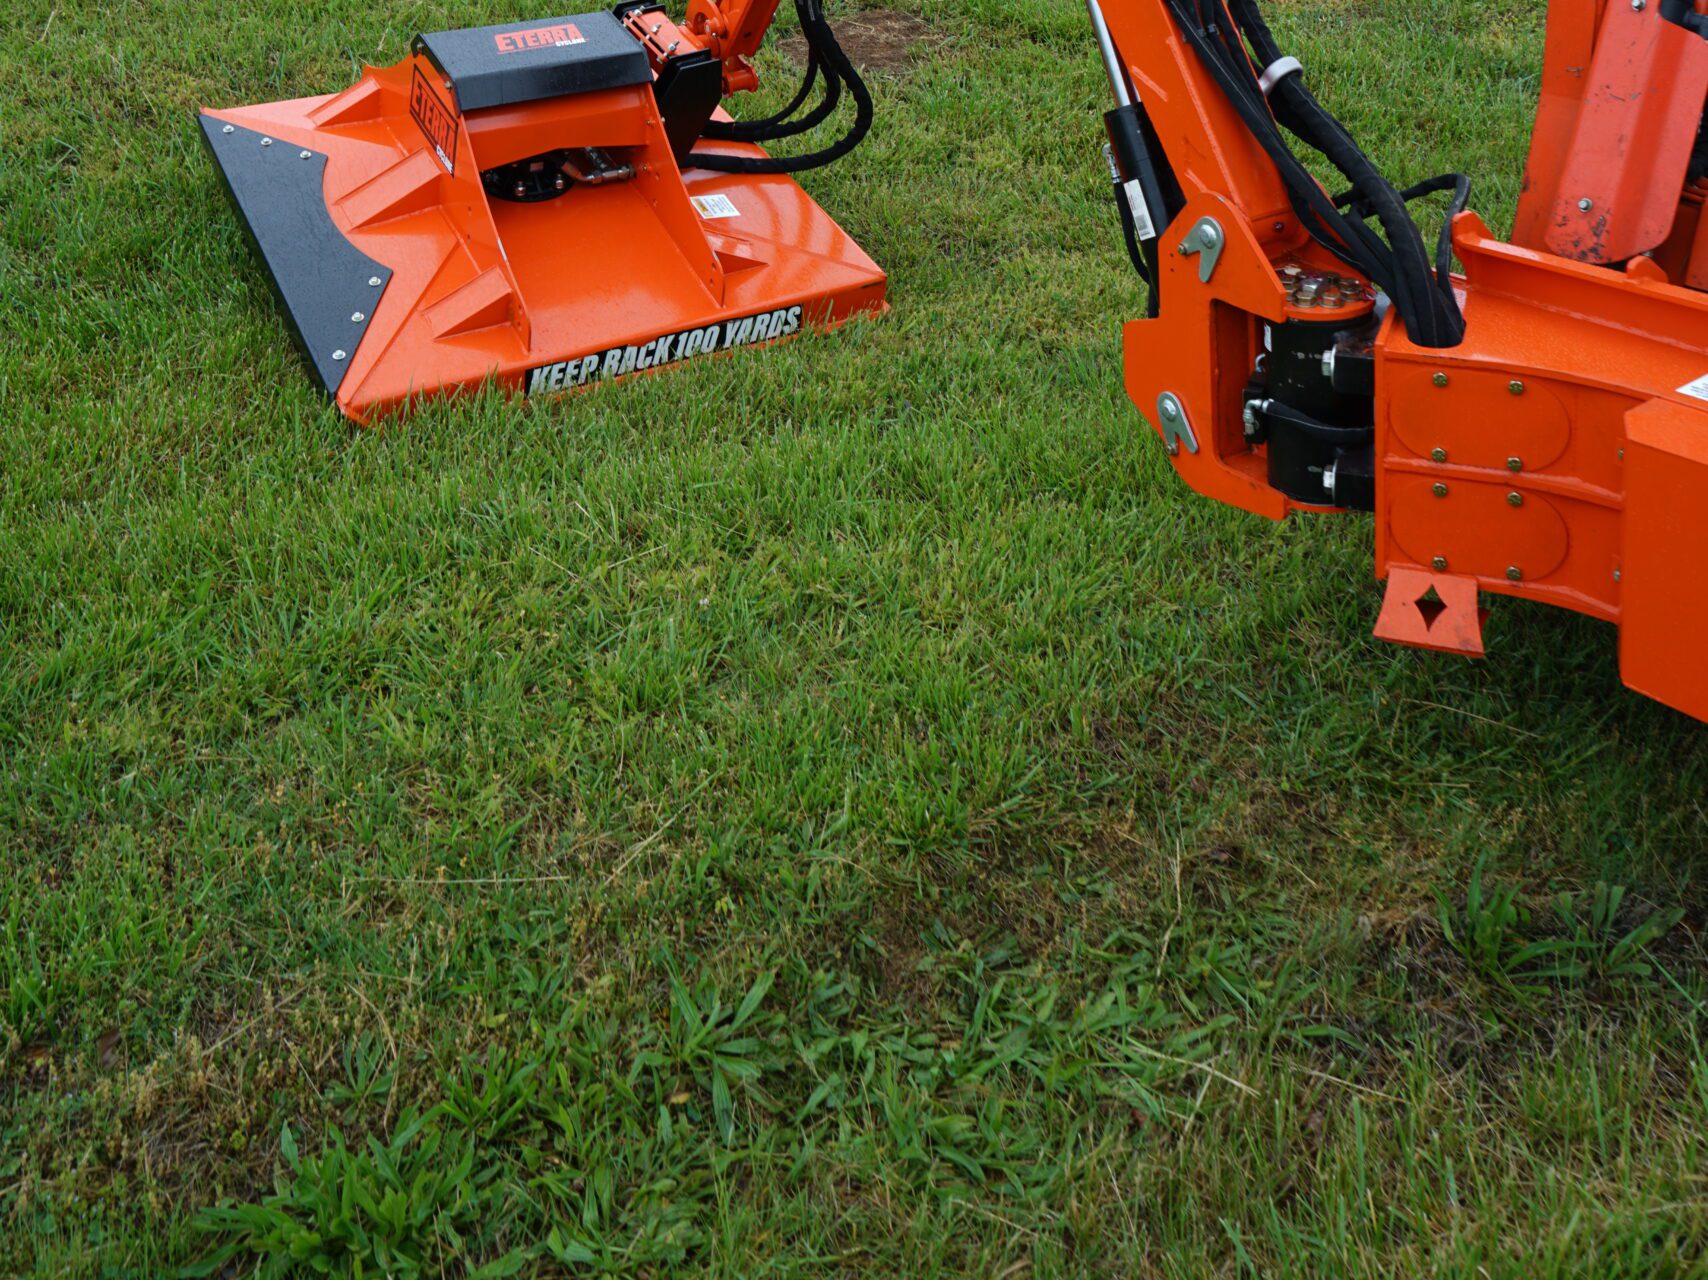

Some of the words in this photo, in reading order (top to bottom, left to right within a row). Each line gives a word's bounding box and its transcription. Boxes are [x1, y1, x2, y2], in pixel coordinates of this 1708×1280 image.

[497, 24, 584, 52] ETERRA
[411, 77, 455, 162] ETERRA
[529, 353, 599, 394] KEEP
[602, 336, 675, 376] BACK
[675, 325, 720, 358] 100
[722, 306, 802, 348] YARDS
